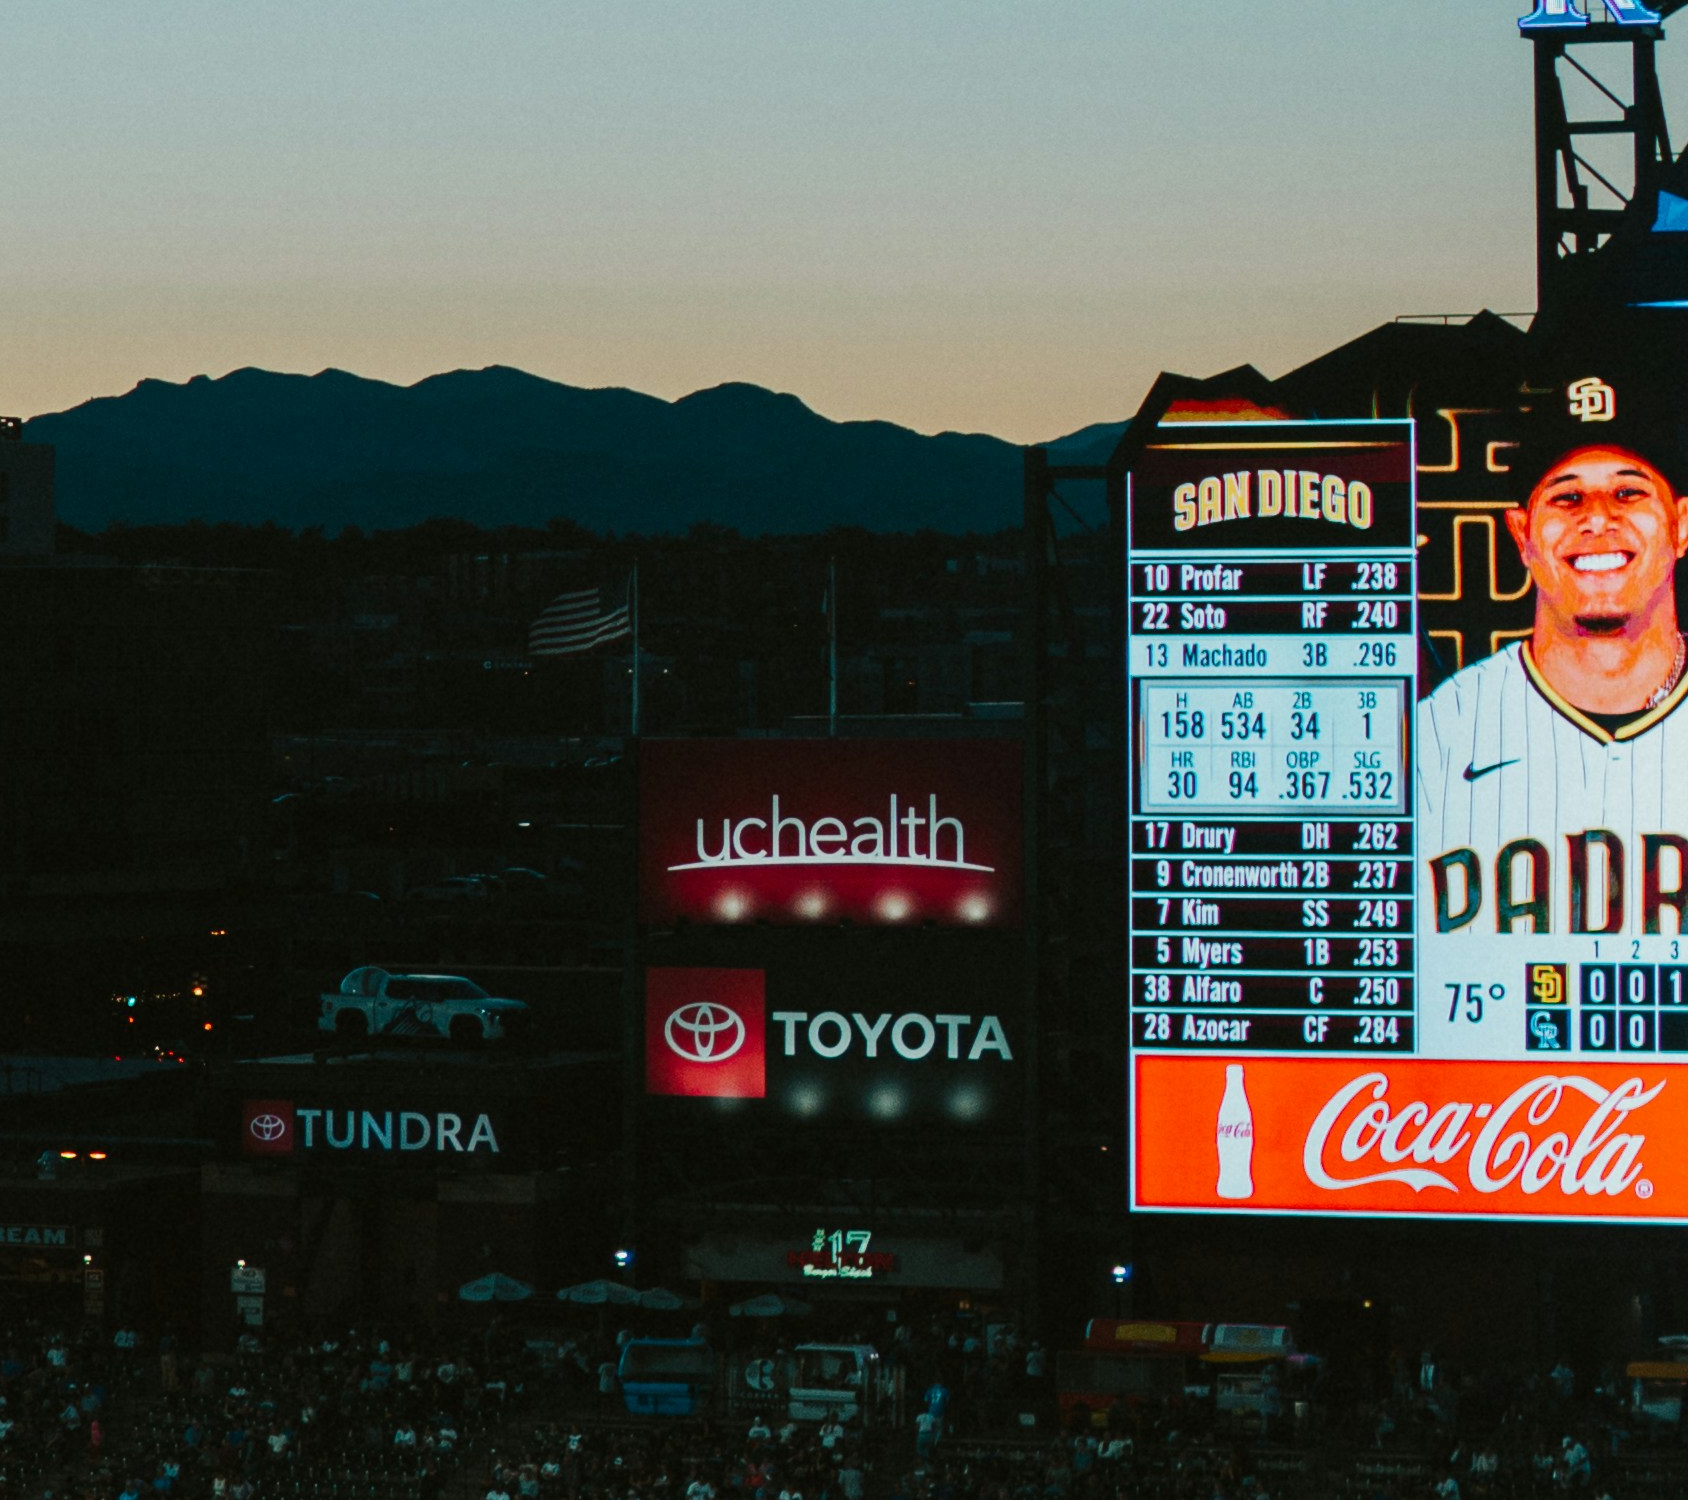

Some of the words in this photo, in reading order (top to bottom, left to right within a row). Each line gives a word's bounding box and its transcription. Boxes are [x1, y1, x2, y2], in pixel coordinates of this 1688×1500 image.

[1173, 470, 1252, 531] SAN
[1257, 469, 1374, 530] DIEGO
[1144, 564, 1170, 591] 10
[1180, 563, 1244, 591] Profar
[1302, 563, 1328, 590] LF
[1351, 562, 1399, 590] .238
[1142, 602, 1170, 629] 22
[1180, 602, 1227, 629] Soto
[1301, 601, 1329, 628] RF
[1351, 601, 1399, 628] .240
[1146, 642, 1169, 667] 13
[1182, 642, 1268, 667] Machado
[1302, 642, 1328, 667] 3B
[1353, 642, 1397, 667] .296
[1176, 692, 1187, 709] H
[1232, 692, 1254, 709] AB
[1292, 691, 1312, 709] 2B
[1358, 691, 1377, 709] 3B
[1161, 711, 1205, 739] 158
[1221, 711, 1266, 740] 534
[1290, 711, 1321, 740] 34
[1362, 712, 1372, 740] 1
[1171, 751, 1194, 768] HR
[1230, 751, 1256, 768] RBI
[1286, 751, 1320, 769] OBP
[1353, 751, 1381, 769] SLG
[1167, 771, 1198, 799] 30
[1229, 771, 1259, 799] 94
[1278, 771, 1331, 799] .367
[1342, 771, 1393, 800] .532
[696, 793, 965, 862] uchealth
[1145, 821, 1171, 848] 17
[1181, 821, 1236, 855] Drury
[1301, 822, 1330, 850] DH
[1353, 822, 1399, 850] .262
[1156, 860, 1171, 887] 9
[1181, 860, 1299, 887] Cronenworth
[1301, 861, 1330, 888] 2B
[1353, 861, 1399, 889] .237
[1157, 898, 1170, 925] 7
[1181, 898, 1220, 925] Kim
[1301, 899, 1330, 927] SS
[1353, 900, 1400, 927] .249
[1157, 936, 1171, 964] 5
[1181, 936, 1243, 969] Myers
[1304, 938, 1330, 965] 1B
[1353, 938, 1399, 966] .253
[1593, 940, 1600, 959] 1
[1631, 940, 1640, 959] 2
[1670, 940, 1679, 959] 3
[1144, 975, 1171, 1002] 38
[1181, 975, 1243, 1002] Alfaro
[1309, 977, 1324, 1004] C
[1353, 977, 1400, 1005] .250
[1589, 968, 1606, 1004] 0
[1629, 968, 1646, 1004] 0
[1669, 969, 1682, 1004] 1
[771, 1011, 1013, 1062] TOYOTA
[1143, 1013, 1171, 1041] 28
[1181, 1013, 1251, 1041] Azocar
[1303, 1016, 1330, 1043] CF
[1353, 1016, 1399, 1044] .284
[1589, 1013, 1606, 1048] 0
[1629, 1013, 1646, 1048] 0
[296, 1108, 500, 1153] TUNDRA
[1302, 1071, 1668, 1197] Coca-Cola
[811, 1228, 872, 1266] #17
